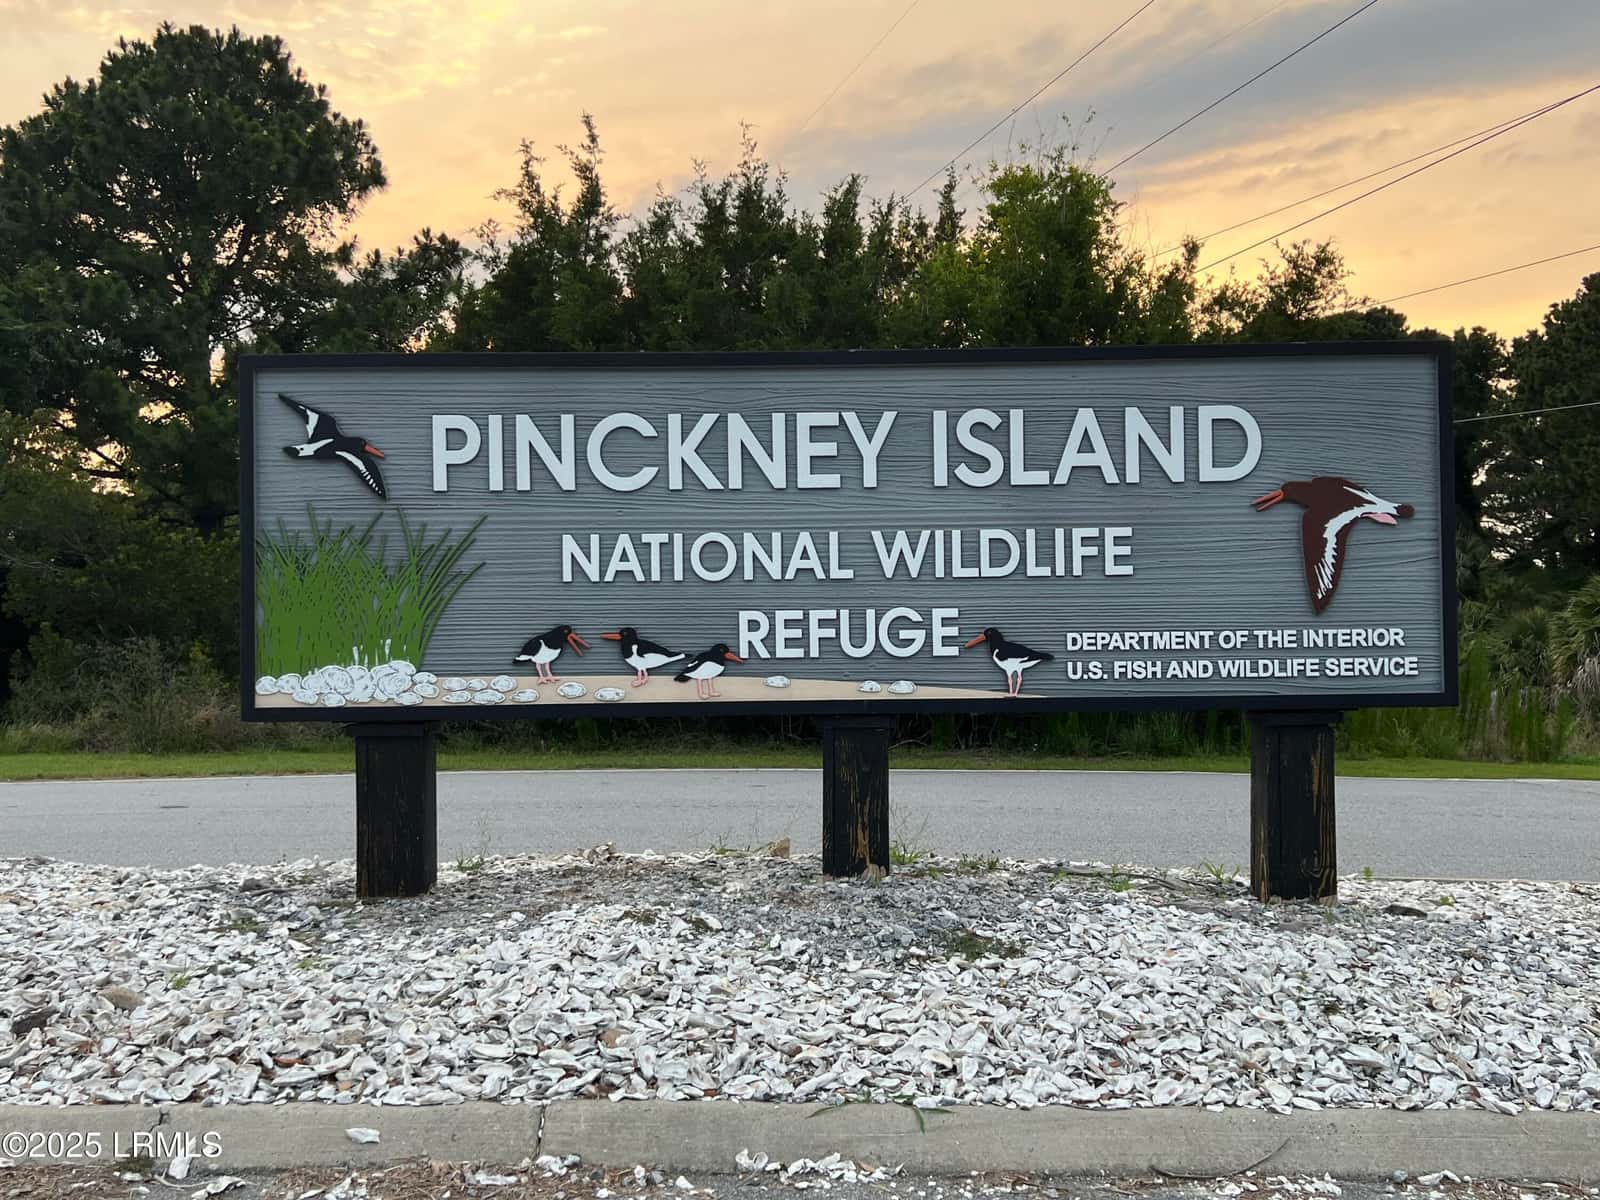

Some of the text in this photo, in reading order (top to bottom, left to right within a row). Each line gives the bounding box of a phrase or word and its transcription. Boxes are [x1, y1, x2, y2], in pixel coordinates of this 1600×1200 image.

[431, 404, 1263, 493] PINCKNEY ISLAND
[561, 526, 1134, 584] NATIONAL WILDLIFE
[737, 606, 961, 660] REFUGE
[1066, 628, 1406, 651] DEPARTMENT OF THE INTERIOR
[1066, 656, 1419, 680] U.S. FISH AND WILDLIFE SERVICE
